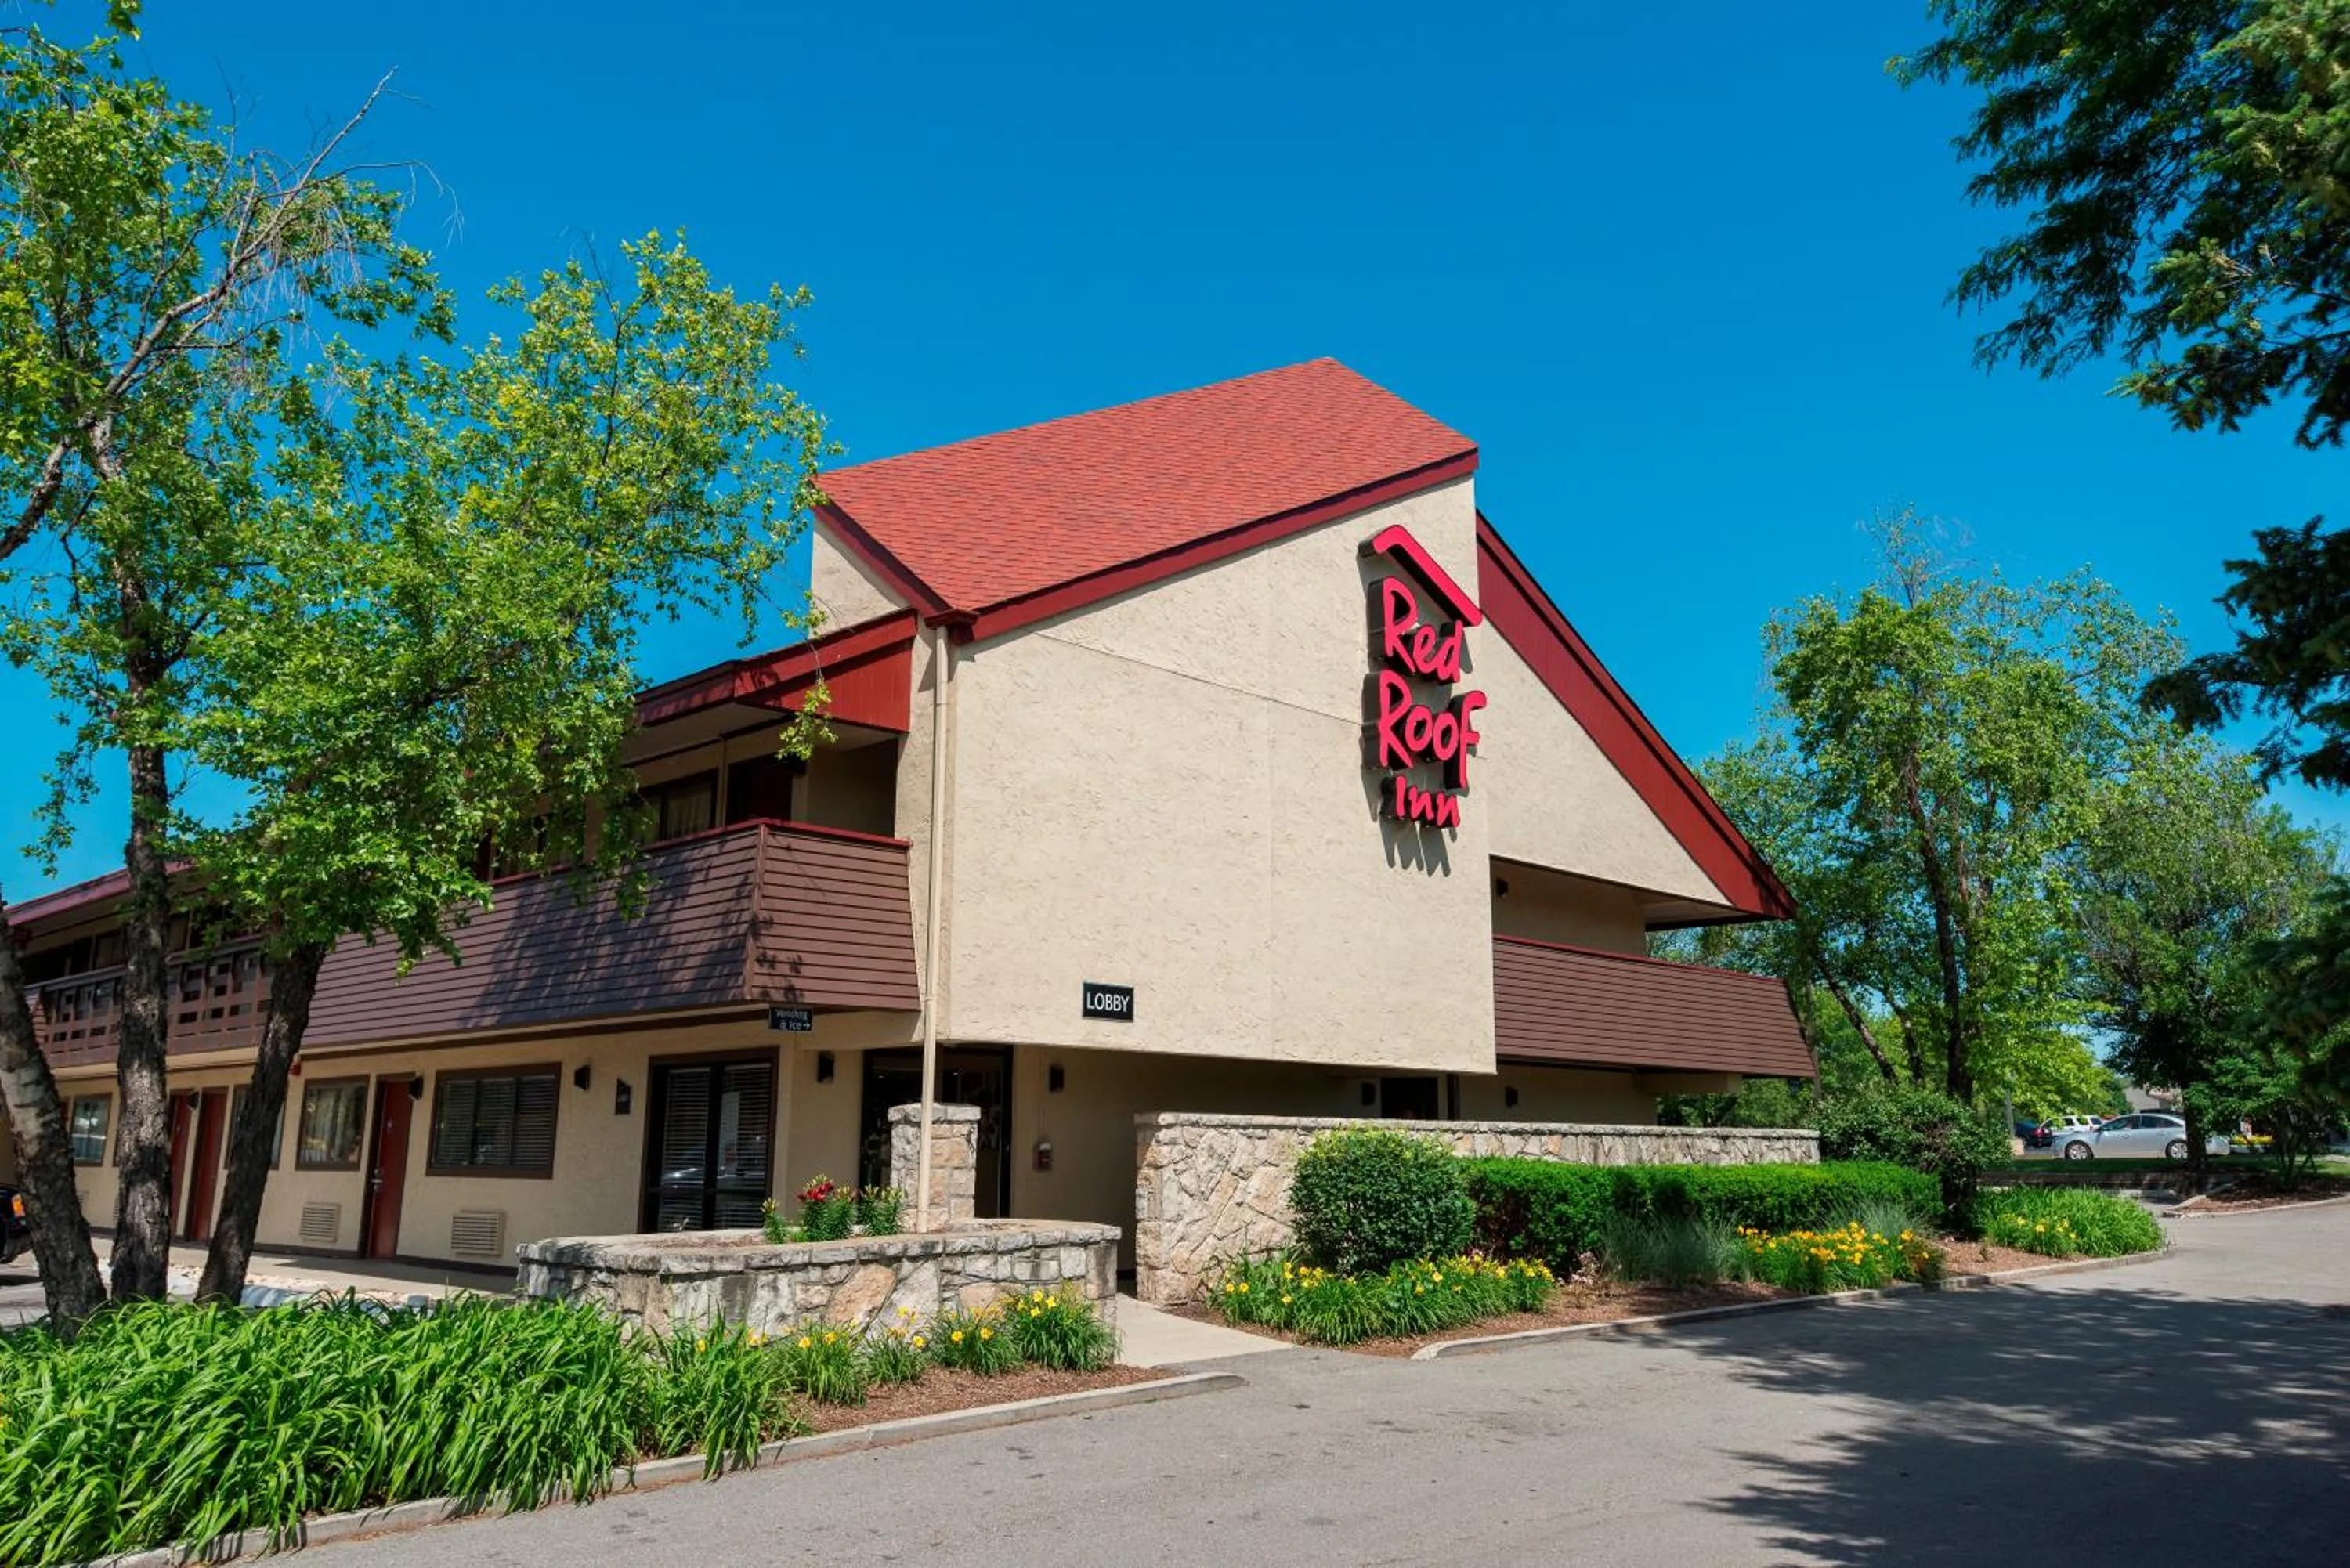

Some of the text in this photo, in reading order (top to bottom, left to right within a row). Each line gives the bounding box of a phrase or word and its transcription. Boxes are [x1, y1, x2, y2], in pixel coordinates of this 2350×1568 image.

[1383, 576, 1464, 682] Red
[1379, 670, 1488, 788] Roof
[1395, 775, 1461, 828] Inn
[1086, 992, 1130, 1013] LOBBY
